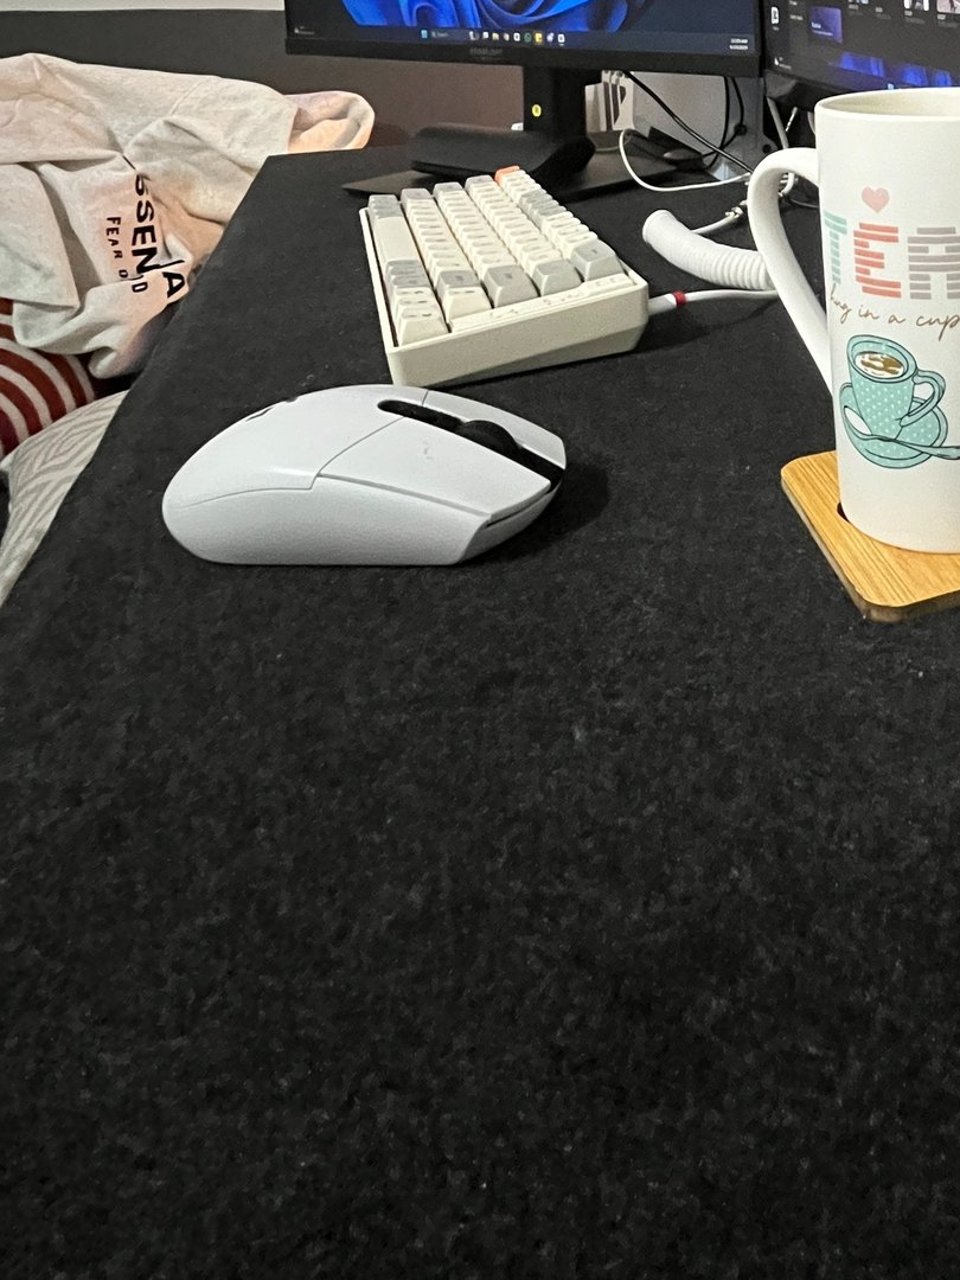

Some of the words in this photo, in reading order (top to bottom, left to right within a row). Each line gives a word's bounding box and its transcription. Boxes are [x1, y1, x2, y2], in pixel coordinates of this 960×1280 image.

[106, 217, 123, 259] FEAR
[858, 305, 880, 320] in
[888, 314, 906, 325] a
